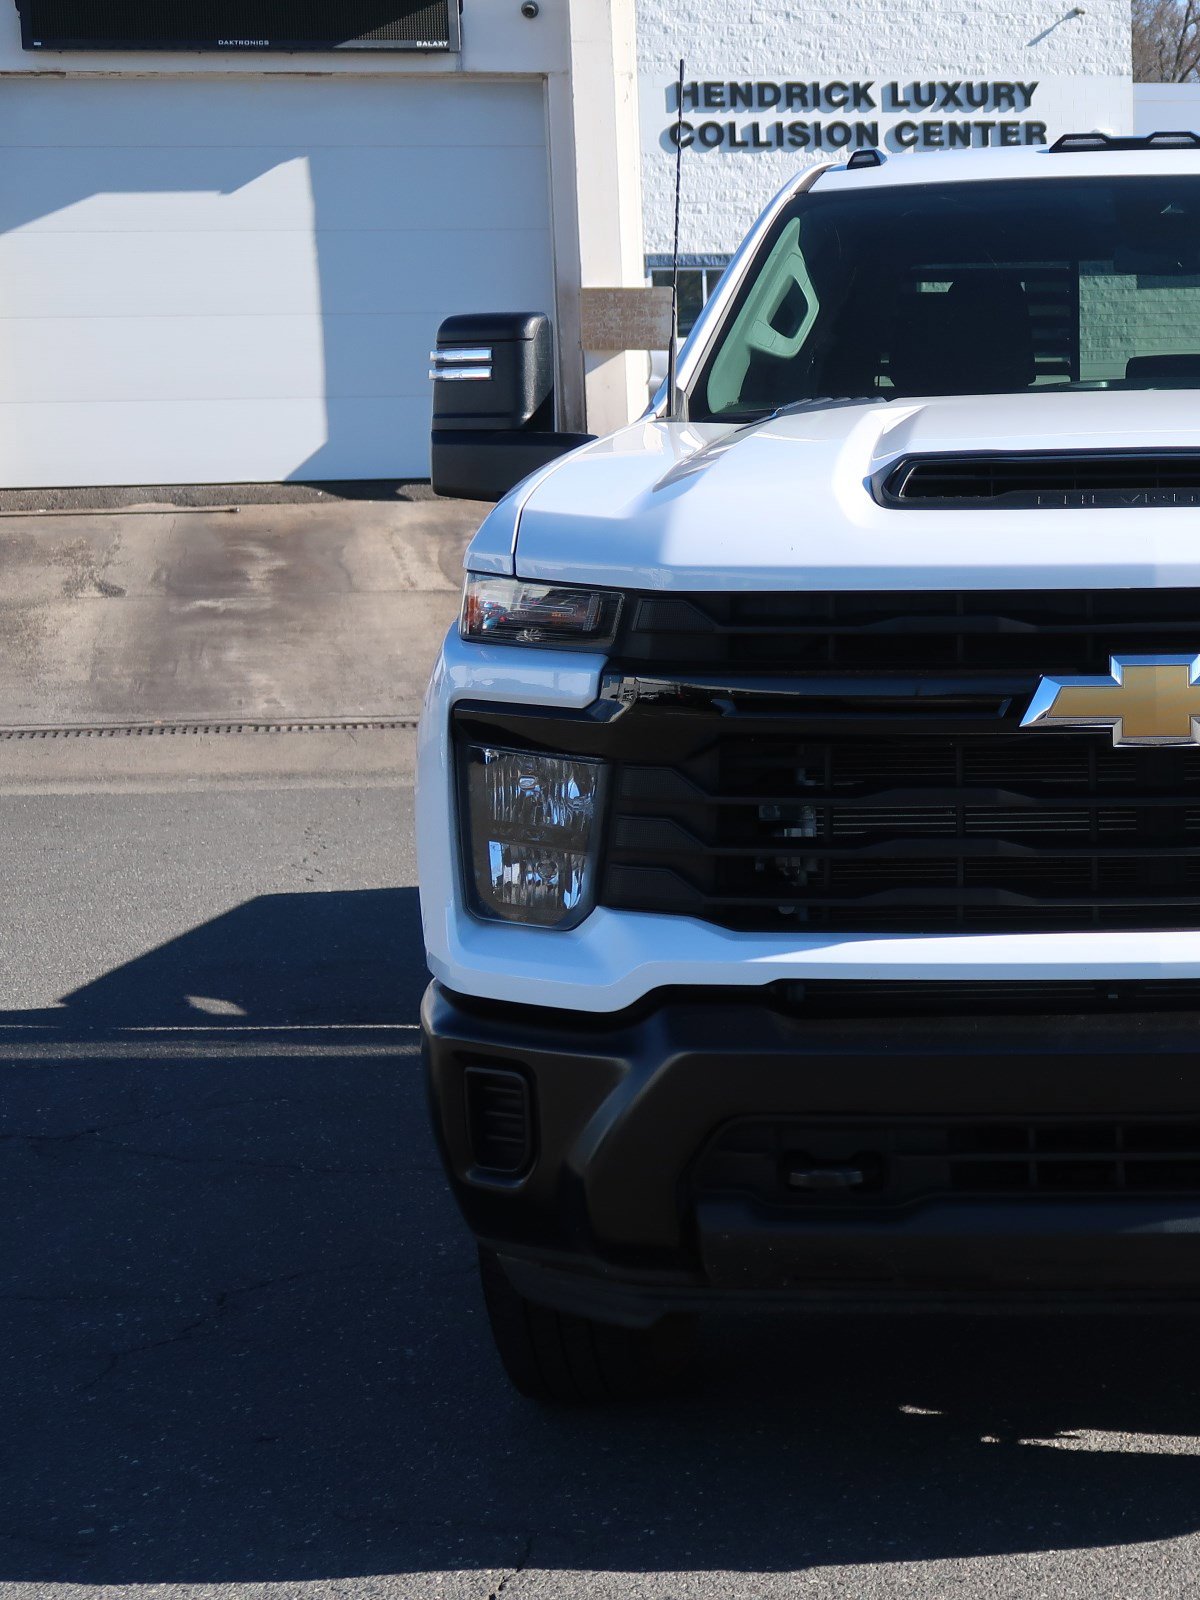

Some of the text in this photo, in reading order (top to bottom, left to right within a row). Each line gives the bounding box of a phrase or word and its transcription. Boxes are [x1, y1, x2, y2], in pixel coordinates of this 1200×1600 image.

[675, 80, 1040, 108] HENDRICK LUXURY
[669, 119, 1047, 149] COLLISION CENTER
